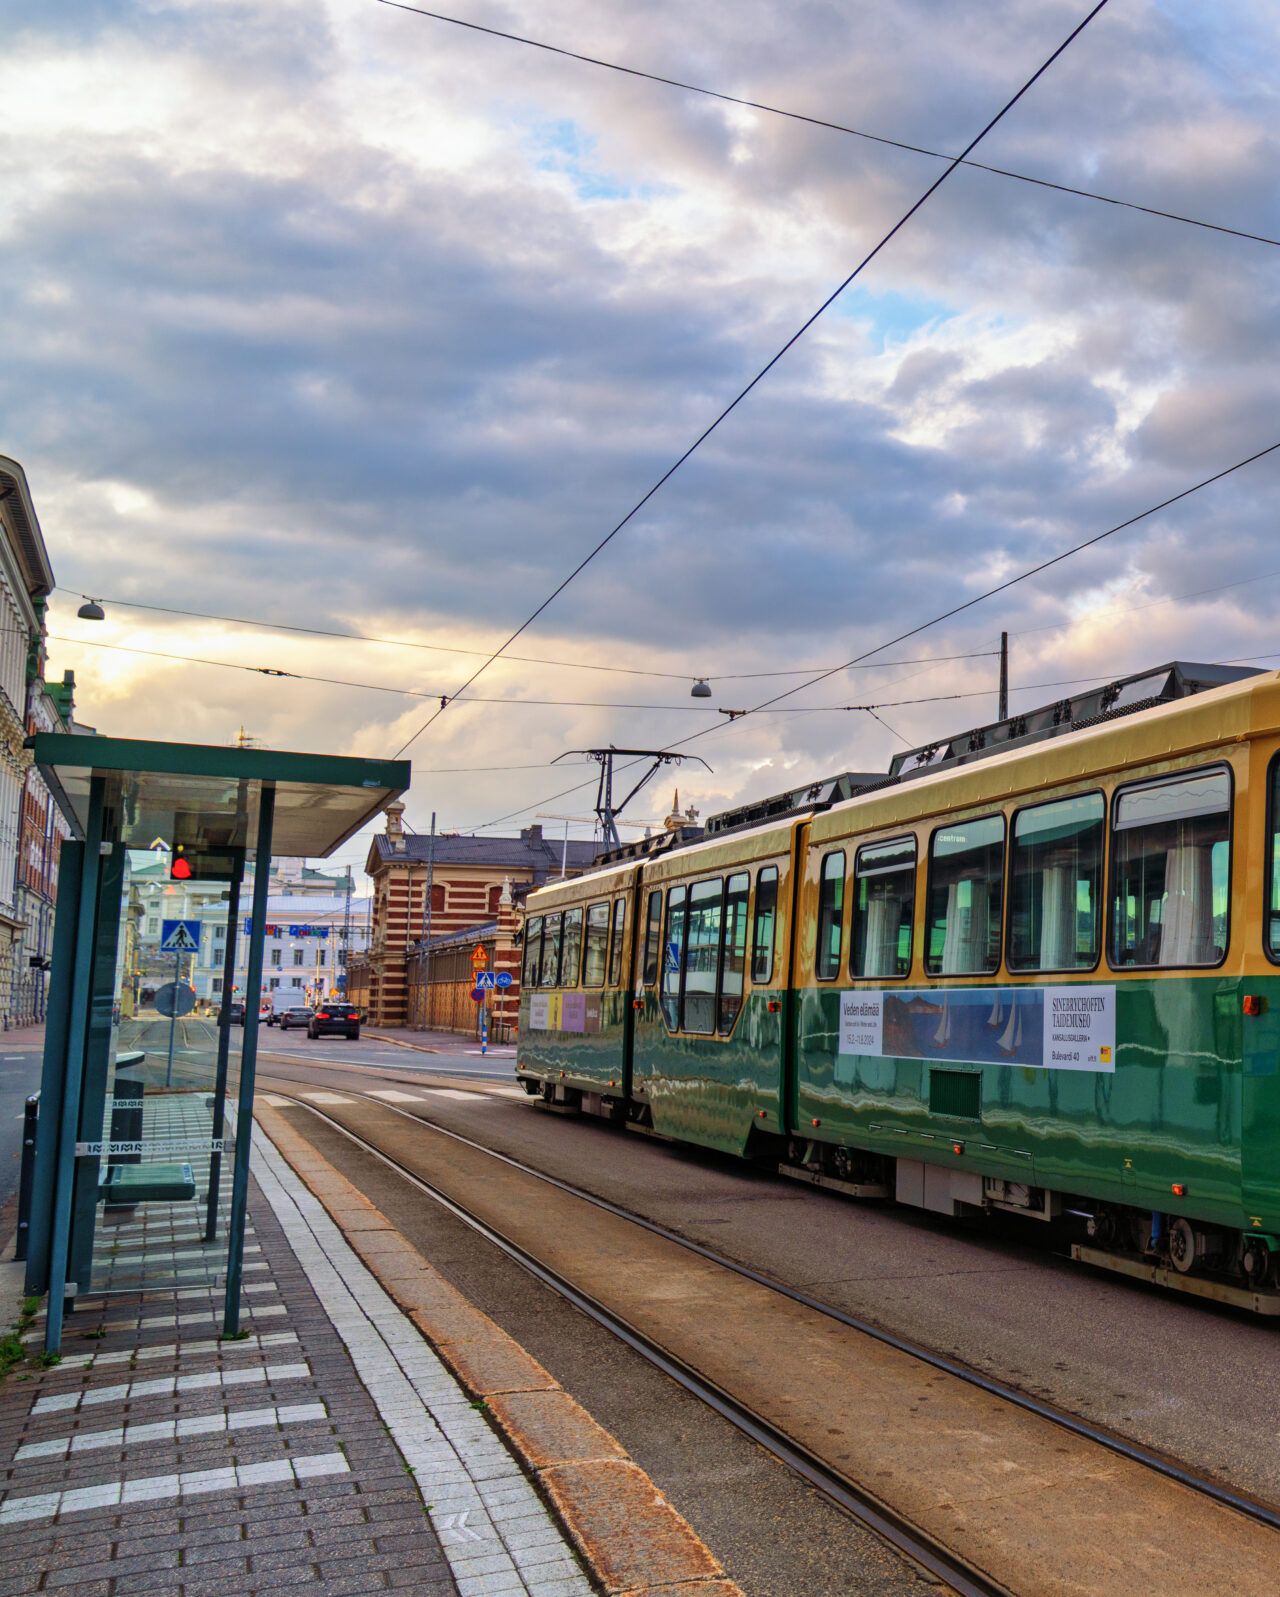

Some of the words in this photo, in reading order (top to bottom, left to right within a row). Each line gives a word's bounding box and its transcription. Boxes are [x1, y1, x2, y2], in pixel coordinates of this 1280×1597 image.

[843, 1002, 859, 1016] Veden
[860, 1002, 879, 1017] elämää
[1052, 997, 1105, 1012] SINEBRYCHOFFIN
[1052, 1013, 1091, 1028] TAIDEMUSEO
[1051, 1050, 1072, 1062] Bulevardi
